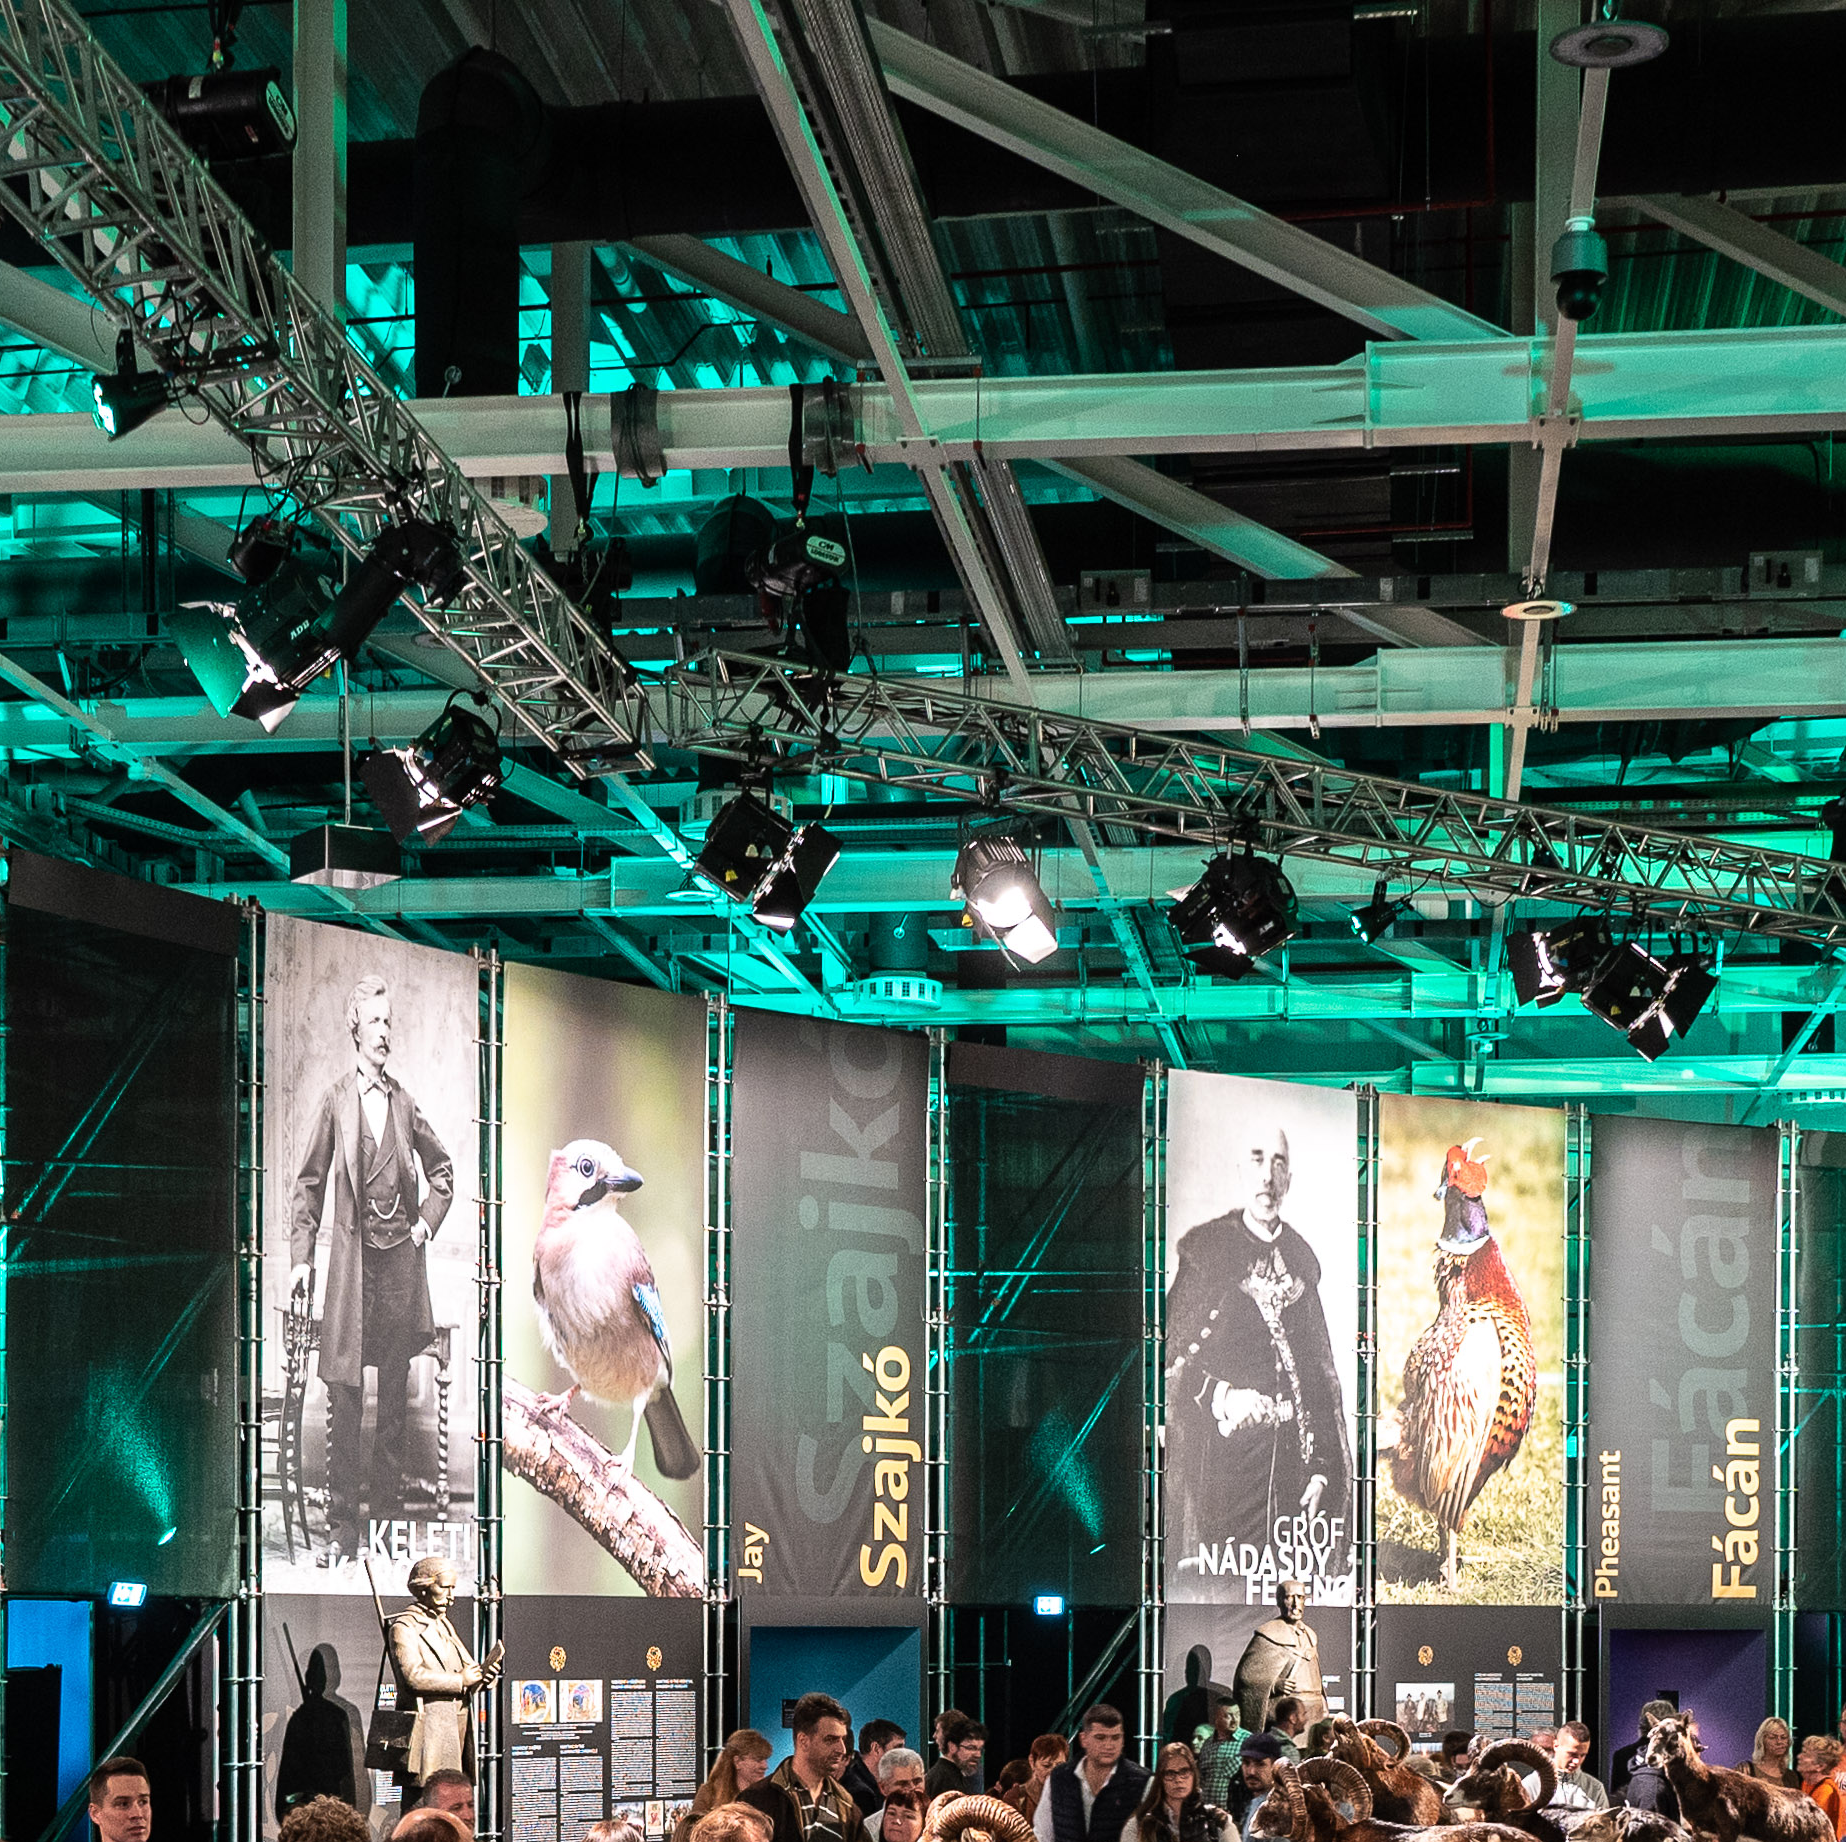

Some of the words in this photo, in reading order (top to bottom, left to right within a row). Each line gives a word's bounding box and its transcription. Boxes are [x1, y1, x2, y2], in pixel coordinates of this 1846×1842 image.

[859, 1344, 923, 1590] Szajkó
[1273, 1510, 1346, 1550] GRÓF
[1594, 1449, 1622, 1600] Pheasant
[1711, 1417, 1761, 1599] Fácán
[368, 1519, 472, 1562] KELETI
[737, 1521, 772, 1585] Jay
[1198, 1536, 1332, 1578] NÁDASDY
